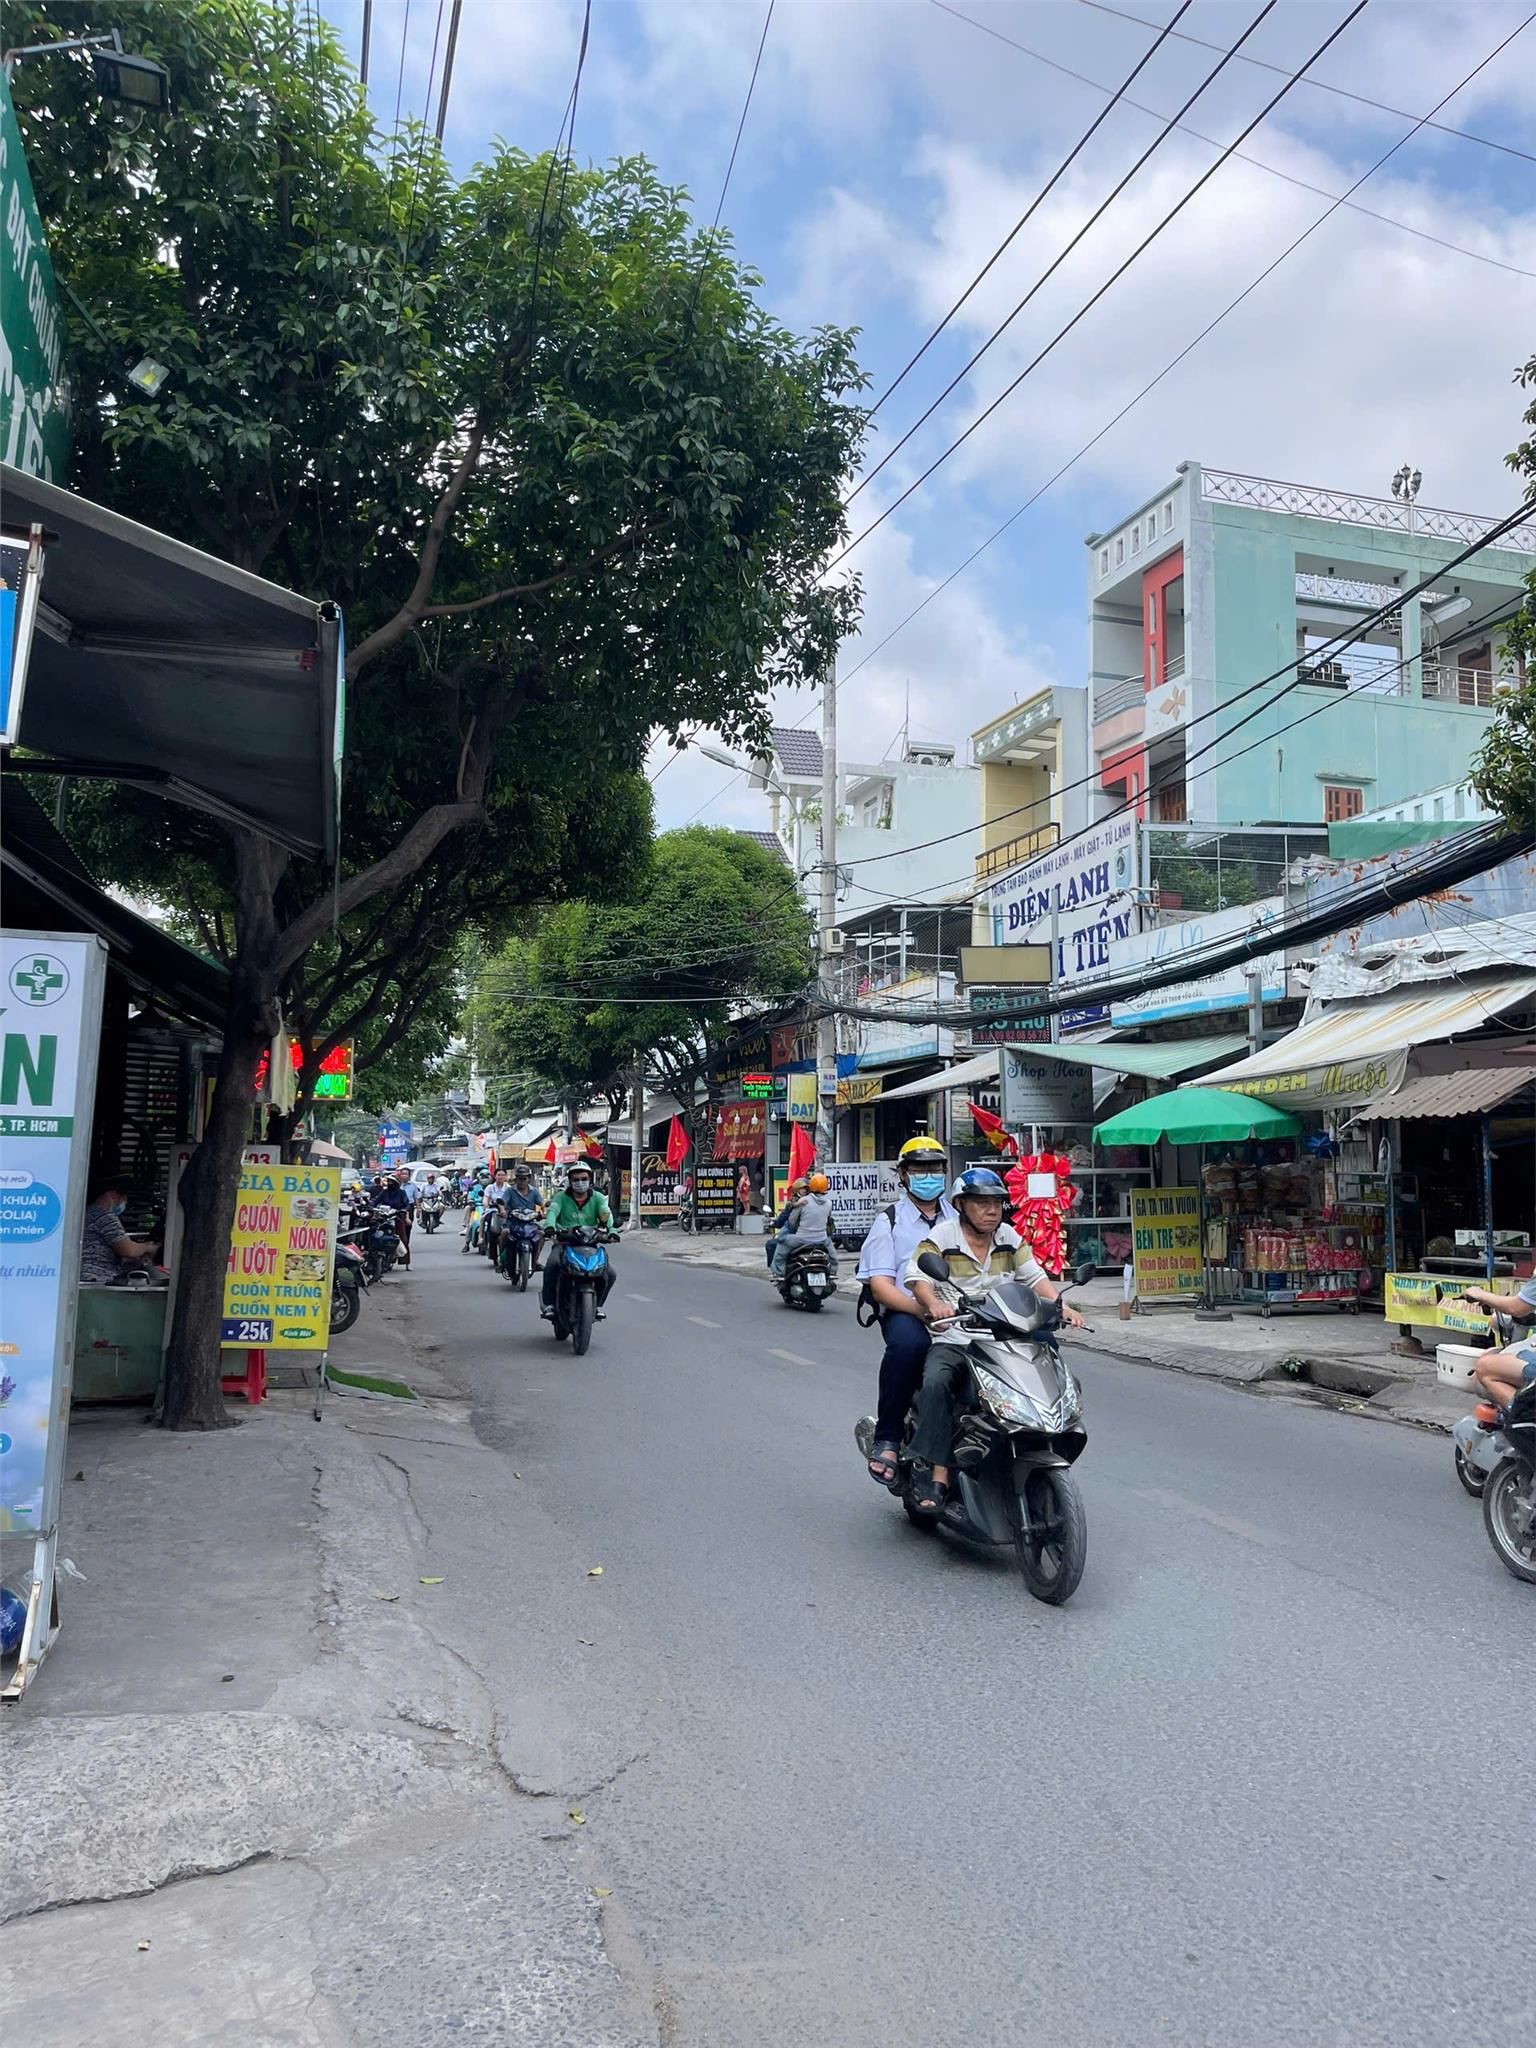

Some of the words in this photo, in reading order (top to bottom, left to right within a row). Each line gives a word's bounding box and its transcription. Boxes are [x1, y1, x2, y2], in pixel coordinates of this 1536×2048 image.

[1073, 844, 1086, 861] MÁY
[1115, 821, 1131, 844] LẠNH
[1007, 1060, 1047, 1081] Shop
[1314, 1062, 1389, 1098] Muội
[10, 1120, 27, 1132] TP.
[30, 1120, 58, 1132] HCM
[282, 1171, 330, 1194] BẢO
[851, 1174, 878, 1194] LẠNH
[238, 1194, 281, 1234] CUỐN
[1136, 1222, 1153, 1250] BẾN
[1156, 1228, 1174, 1249] TRE
[230, 1280, 269, 1297] CUỐN
[274, 1282, 322, 1298] TRỨNG
[230, 1300, 269, 1316] CUỐN
[275, 1304, 306, 1317] NEM
[311, 1302, 320, 1317] Ý
[238, 1321, 269, 1341] 25k
